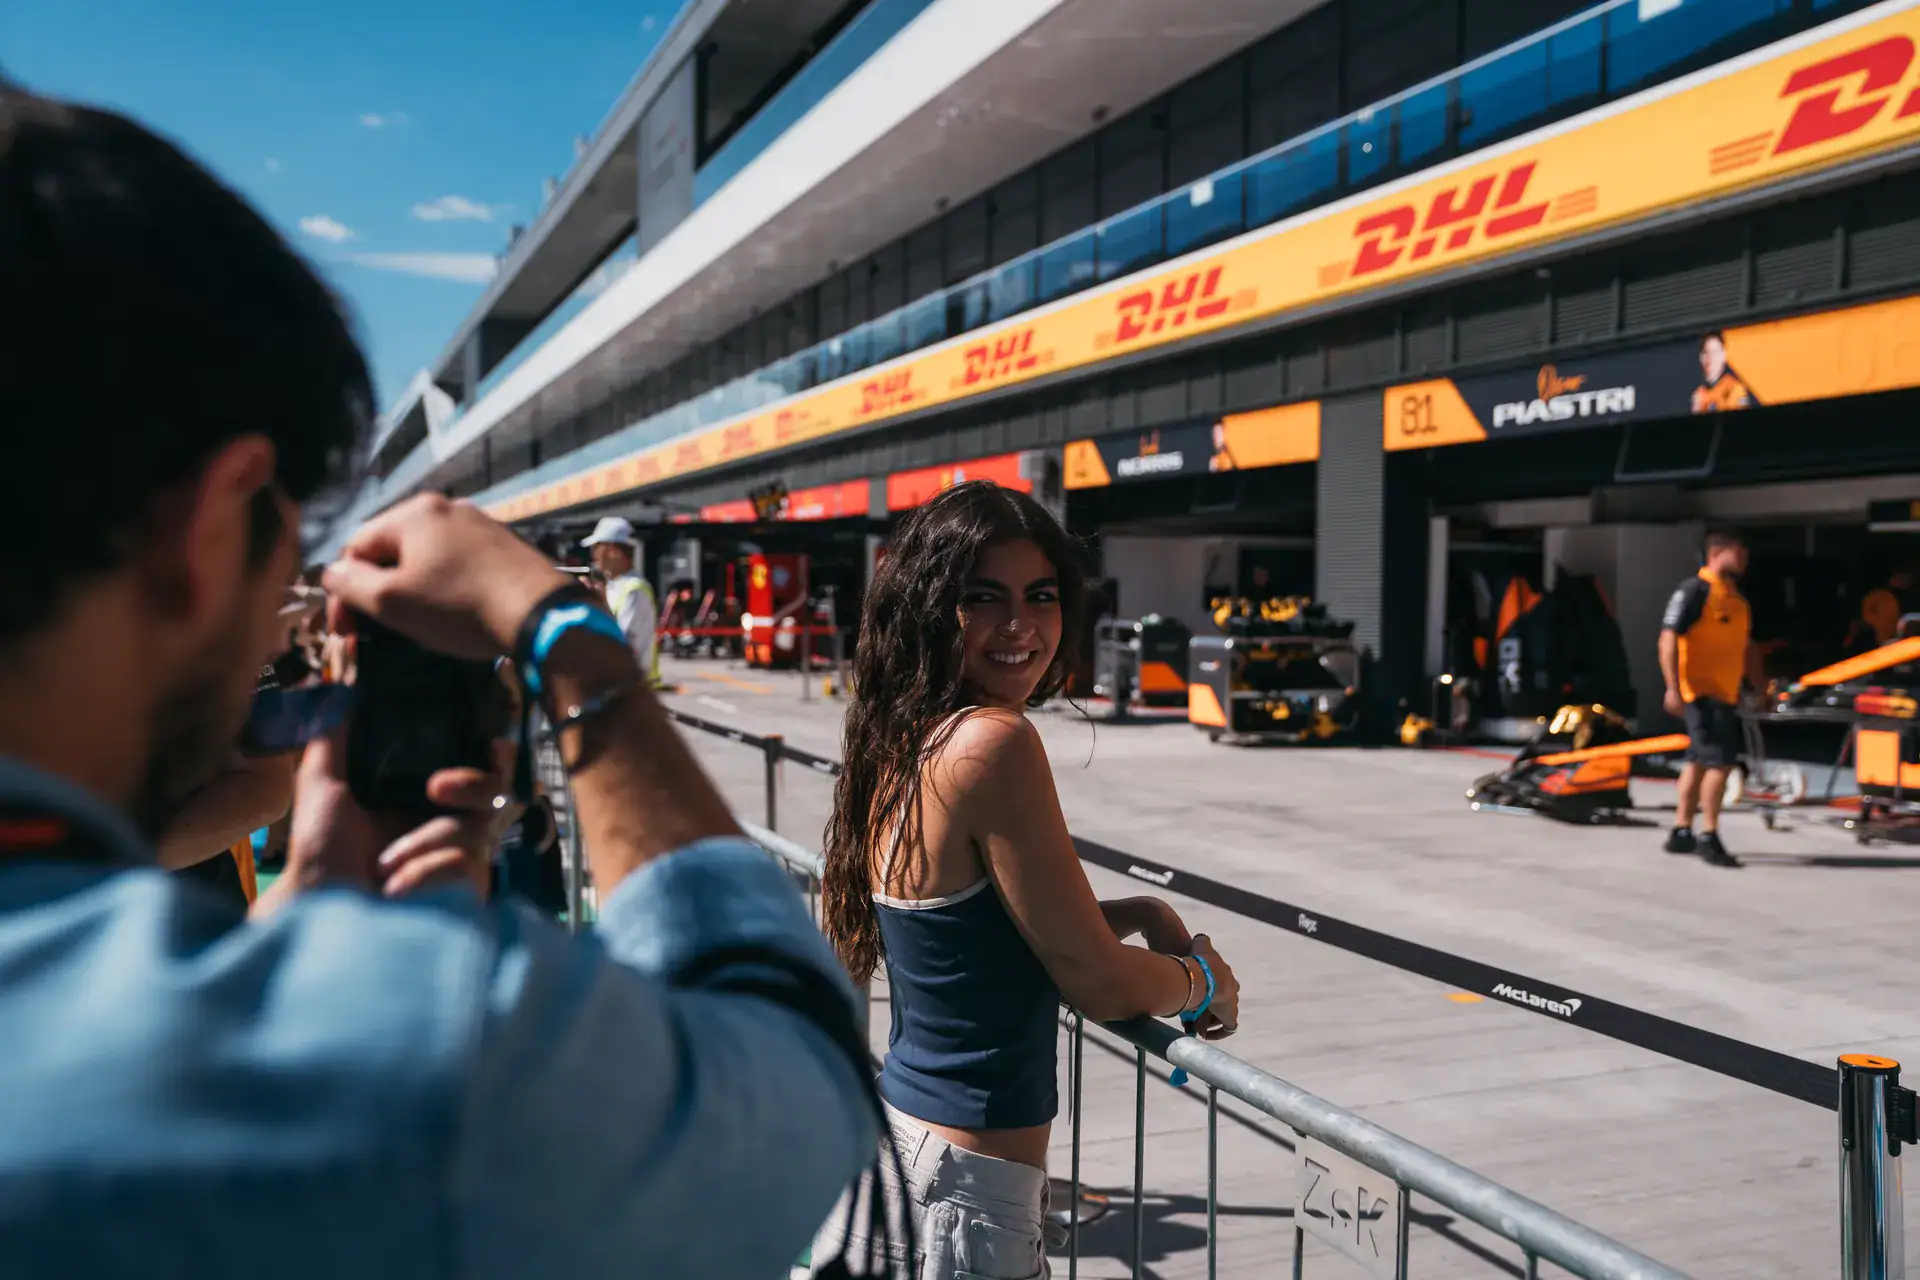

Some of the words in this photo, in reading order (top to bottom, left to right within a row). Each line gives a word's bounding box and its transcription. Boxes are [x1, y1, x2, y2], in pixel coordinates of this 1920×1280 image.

[1351, 161, 1550, 277] DHL
[1115, 265, 1230, 342] DHL
[963, 329, 1037, 385] DHL
[1400, 394, 1438, 436] 81
[1492, 385, 1636, 428] PIASTRI
[1491, 983, 1576, 1017] McLaren
